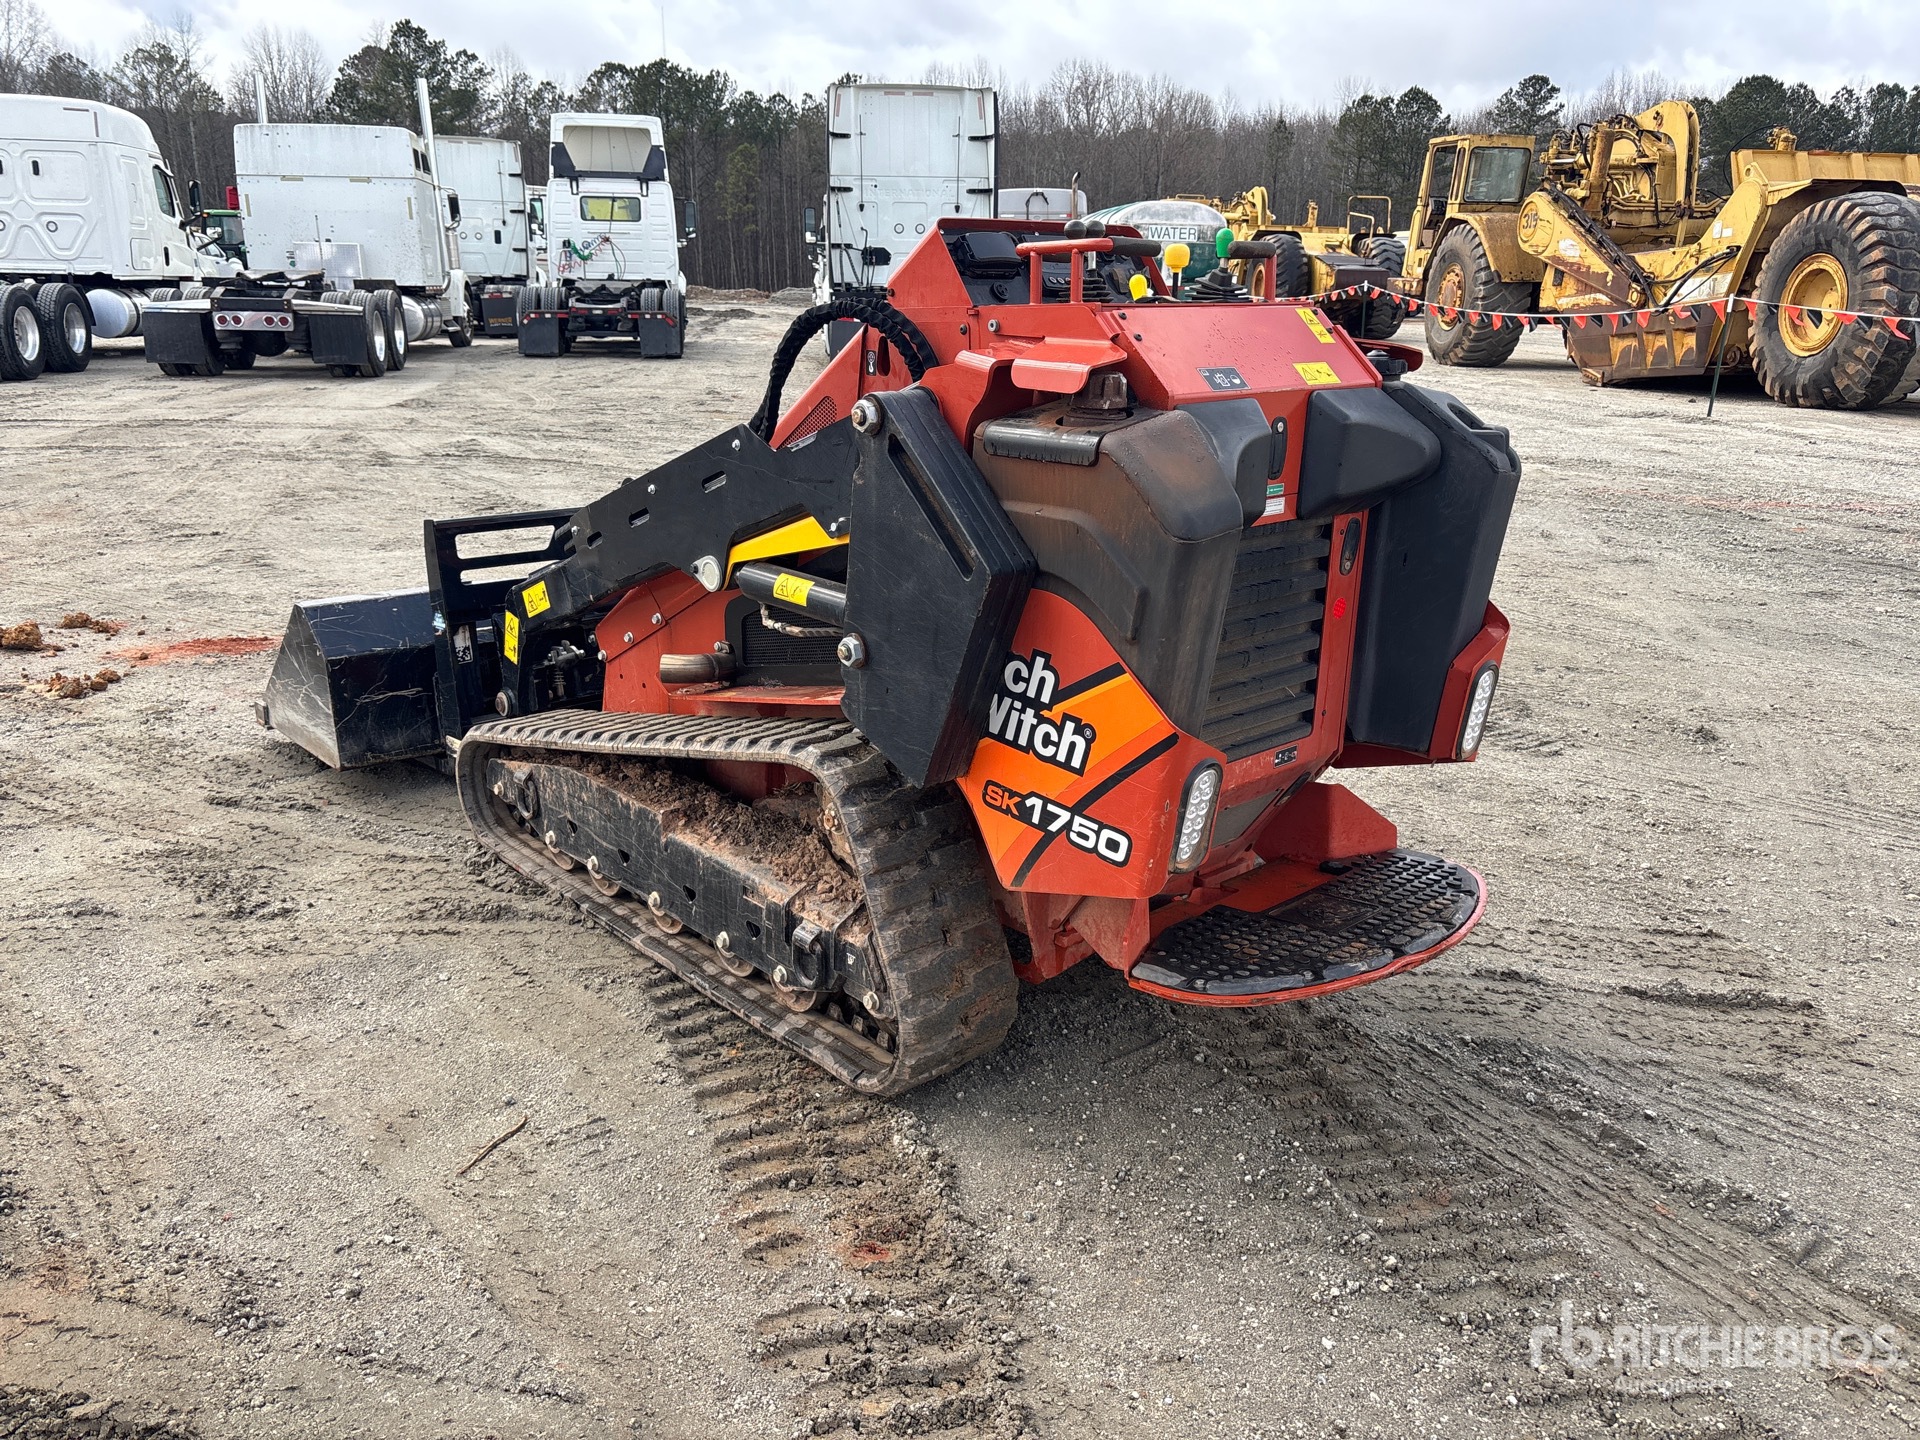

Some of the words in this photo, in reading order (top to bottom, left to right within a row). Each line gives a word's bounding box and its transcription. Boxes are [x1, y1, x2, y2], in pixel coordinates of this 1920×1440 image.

[1150, 226, 1197, 240] WATER
[1004, 656, 1055, 704] ch
[985, 784, 1129, 862] SK1750
